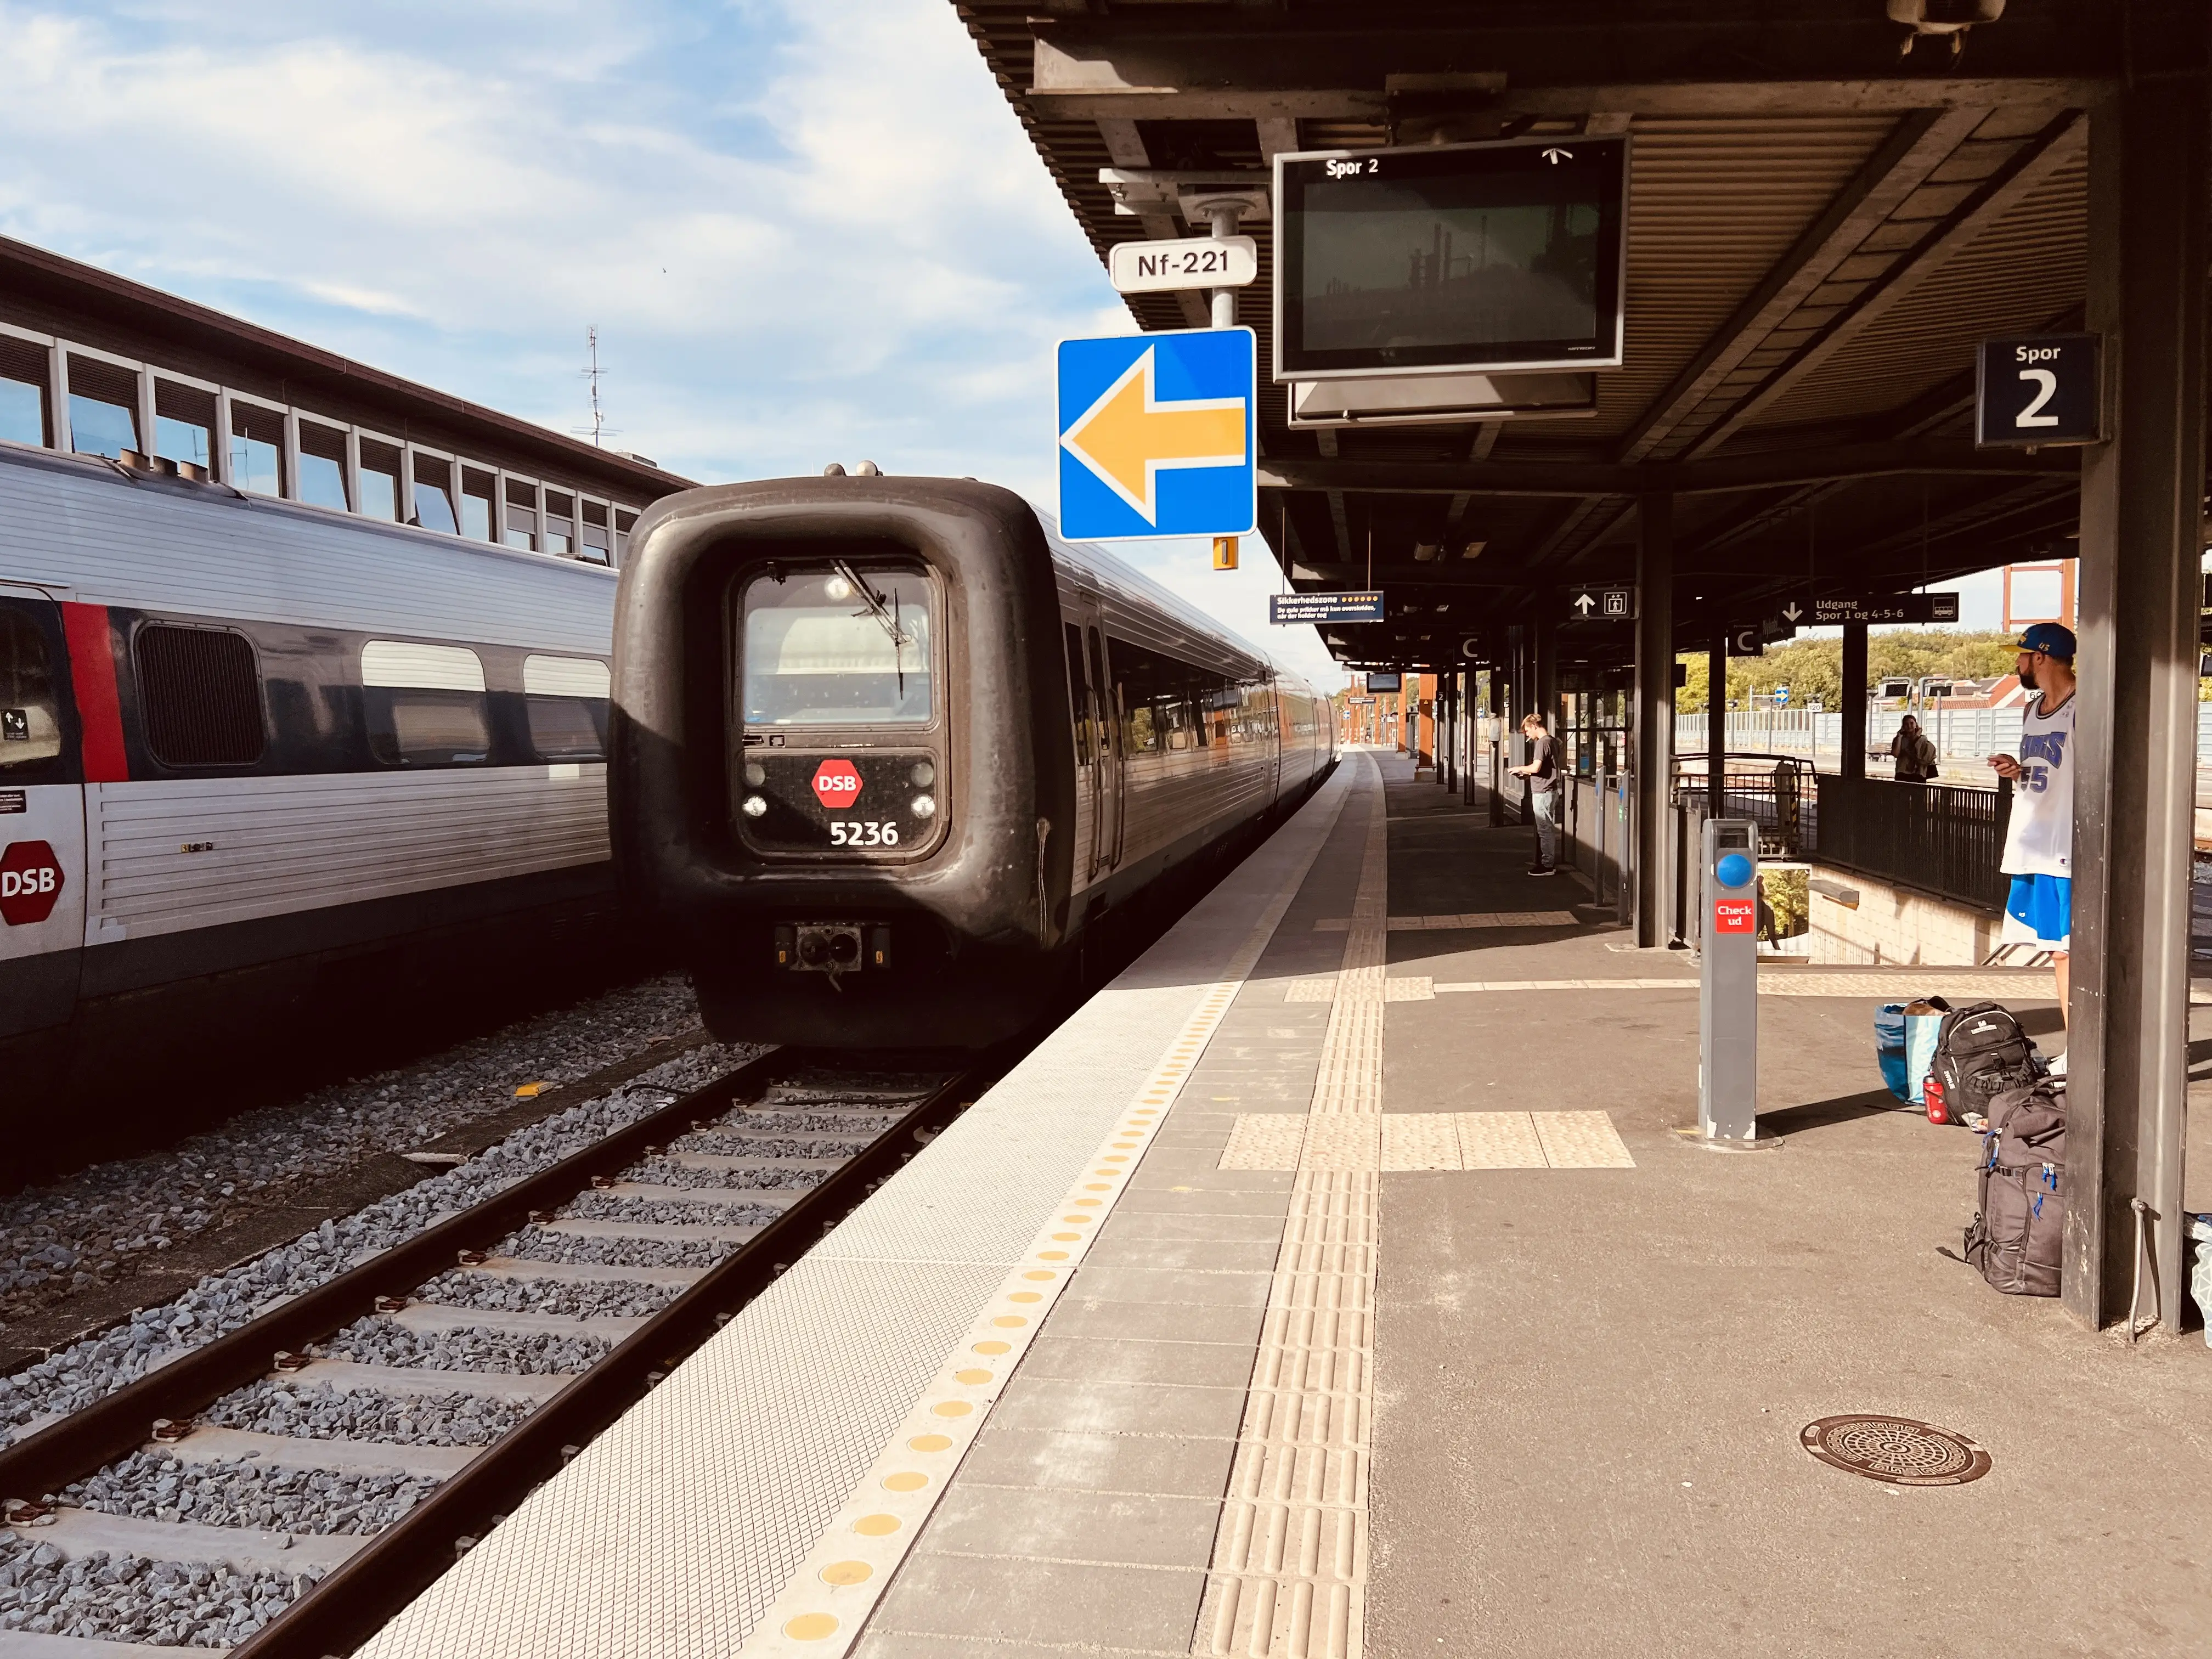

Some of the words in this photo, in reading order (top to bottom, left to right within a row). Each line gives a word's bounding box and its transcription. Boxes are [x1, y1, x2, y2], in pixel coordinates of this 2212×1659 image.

[1326, 159, 1362, 179] Spor
[1369, 159, 1379, 173] 2
[1138, 250, 1229, 277] Nf-221
[2016, 346, 2061, 364] Spor
[2015, 369, 2059, 427] 2
[1277, 596, 1338, 605] Sikkerhedszone
[1816, 600, 1858, 610] Udgang
[1815, 611, 1842, 621] Spor
[1845, 611, 1851, 619] 1
[1854, 611, 1868, 620] og
[1871, 609, 1904, 618] 4-5-6
[1463, 638, 1478, 658] C
[1737, 631, 1753, 651] C
[819, 775, 856, 791] DSB
[830, 821, 899, 846] 5236
[1, 868, 55, 897] DSB
[1718, 906, 1752, 915] Check
[1728, 916, 1742, 926] ud
